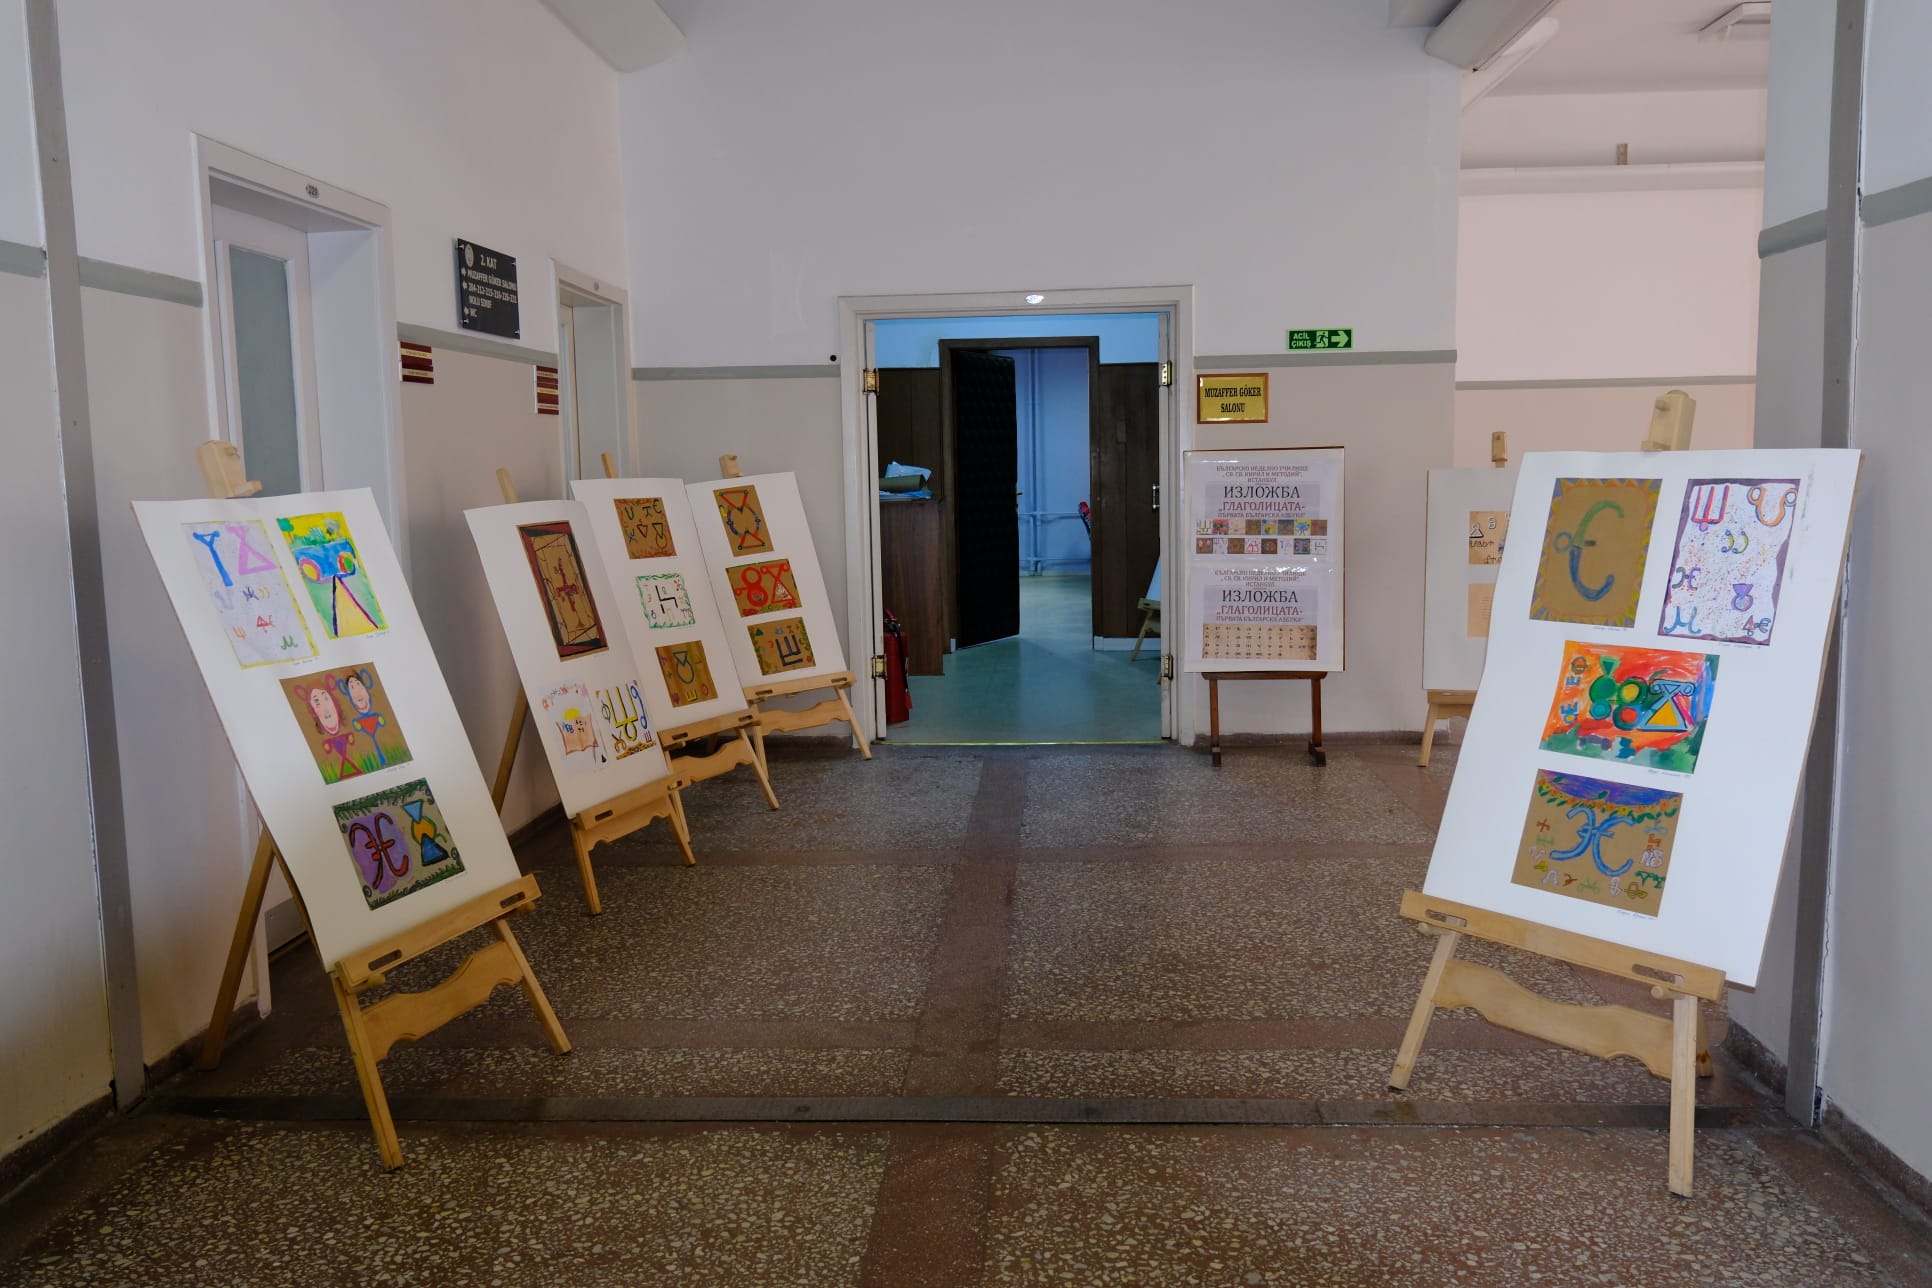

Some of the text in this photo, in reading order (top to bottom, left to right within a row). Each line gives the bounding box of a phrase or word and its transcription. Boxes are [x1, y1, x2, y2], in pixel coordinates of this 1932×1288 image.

[480, 254, 497, 270] 2. KAT
[1293, 331, 1310, 340] ACİL
[1291, 340, 1312, 349] ÇIKIŞ
[1204, 385, 1262, 398] MUZAFFER GÖKER
[1220, 403, 1246, 413] SALONU
[1223, 486, 1301, 499] ИЗЛОЖБА
[1222, 590, 1299, 603] ИЗЛОЖБА
